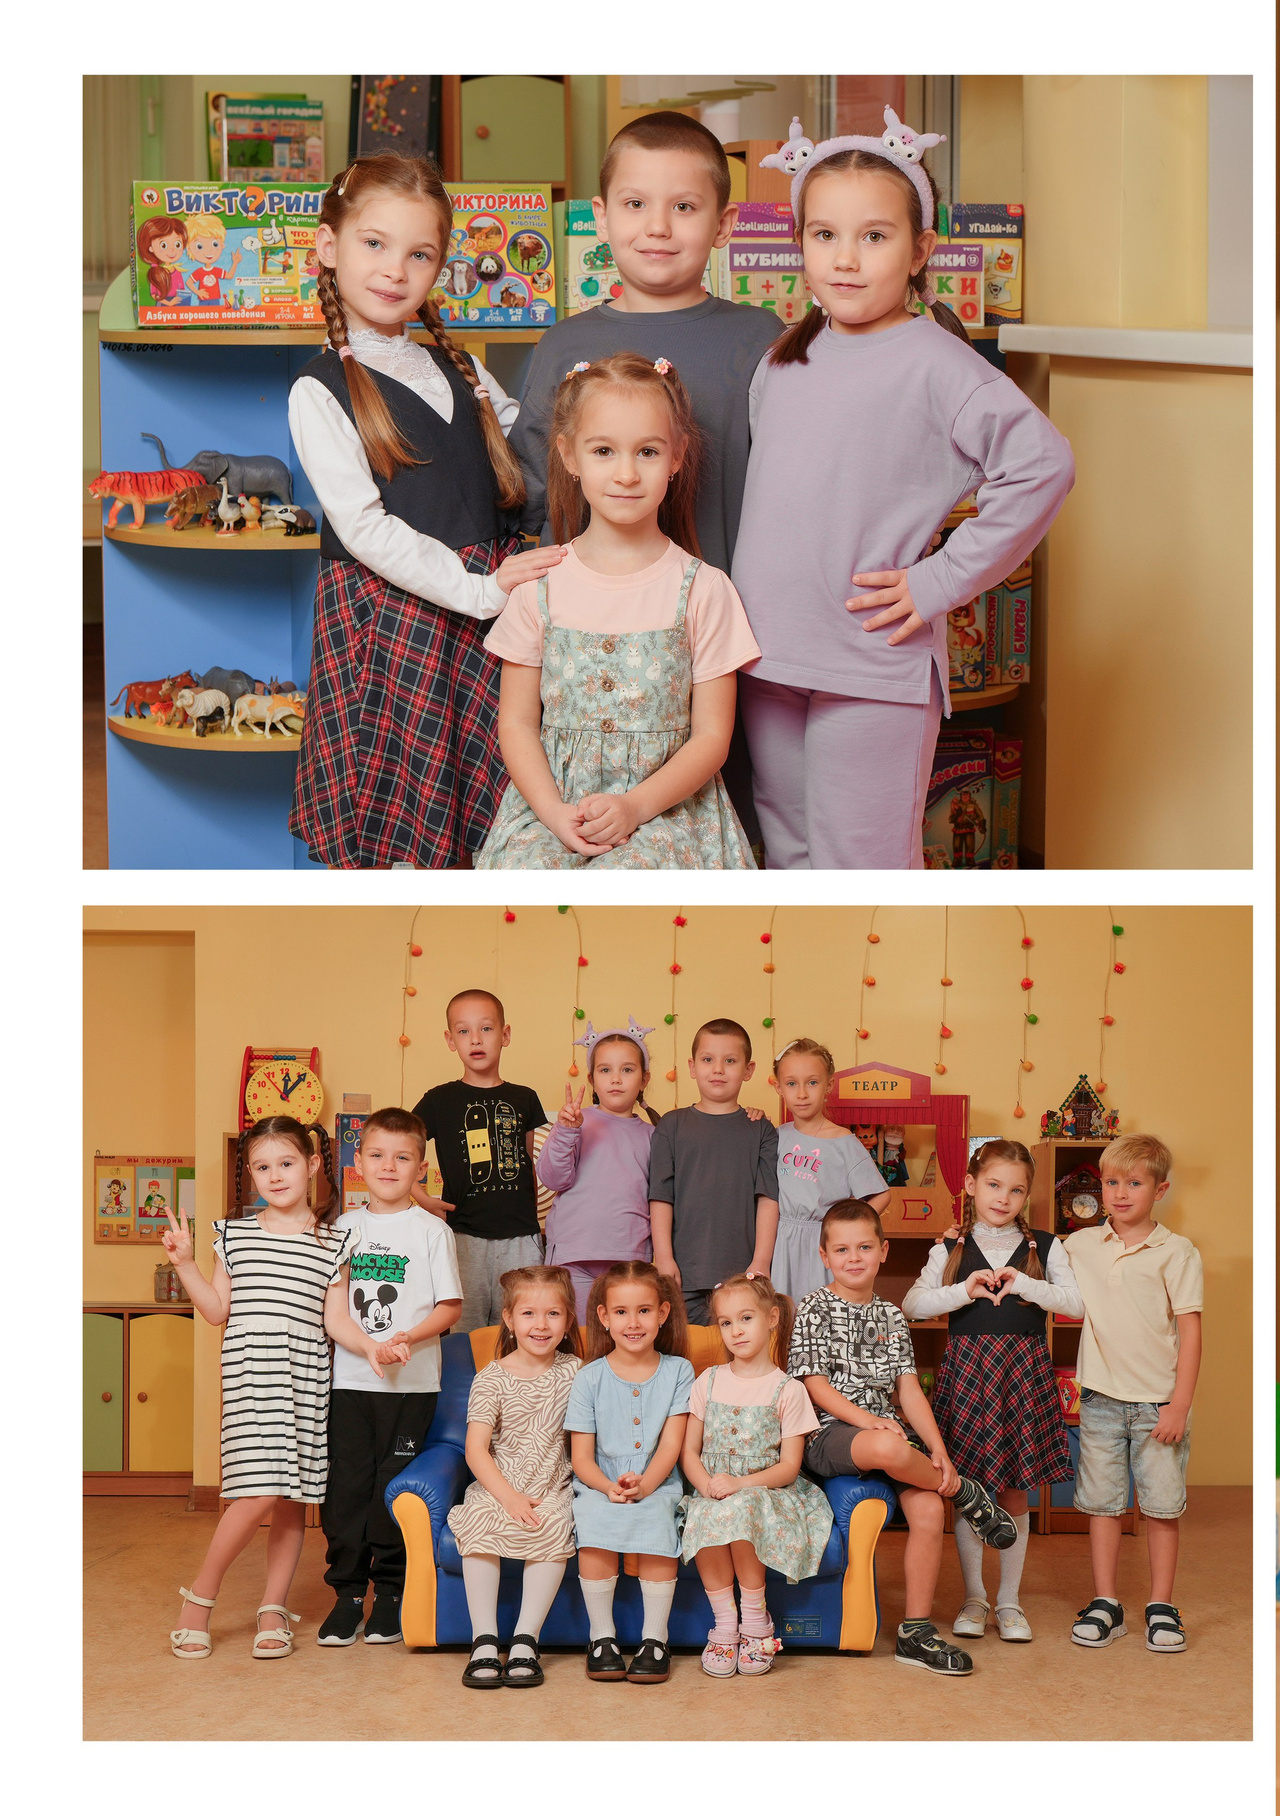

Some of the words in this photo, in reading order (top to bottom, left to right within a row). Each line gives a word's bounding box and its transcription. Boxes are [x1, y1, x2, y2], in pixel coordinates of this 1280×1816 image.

[452, 193, 548, 211] ИКТОРИНА
[286, 216, 319, 226] картин
[735, 275, 752, 295] 1
[781, 275, 798, 294] 7
[936, 275, 955, 294] К
[960, 277, 978, 296] И
[146, 311, 177, 322] Азбука
[179, 312, 219, 321] хорошего
[221, 309, 266, 319] поведения
[985, 594, 998, 662] ПРОФЕССИИ
[1012, 598, 1027, 655] БУКВЫ
[928, 759, 986, 790] ОФЕССИИ
[852, 1081, 898, 1091] ТЕАТР
[783, 1152, 823, 1173] CUTE
[350, 1252, 410, 1270] MICKEY
[350, 1268, 406, 1283] MOUSE
